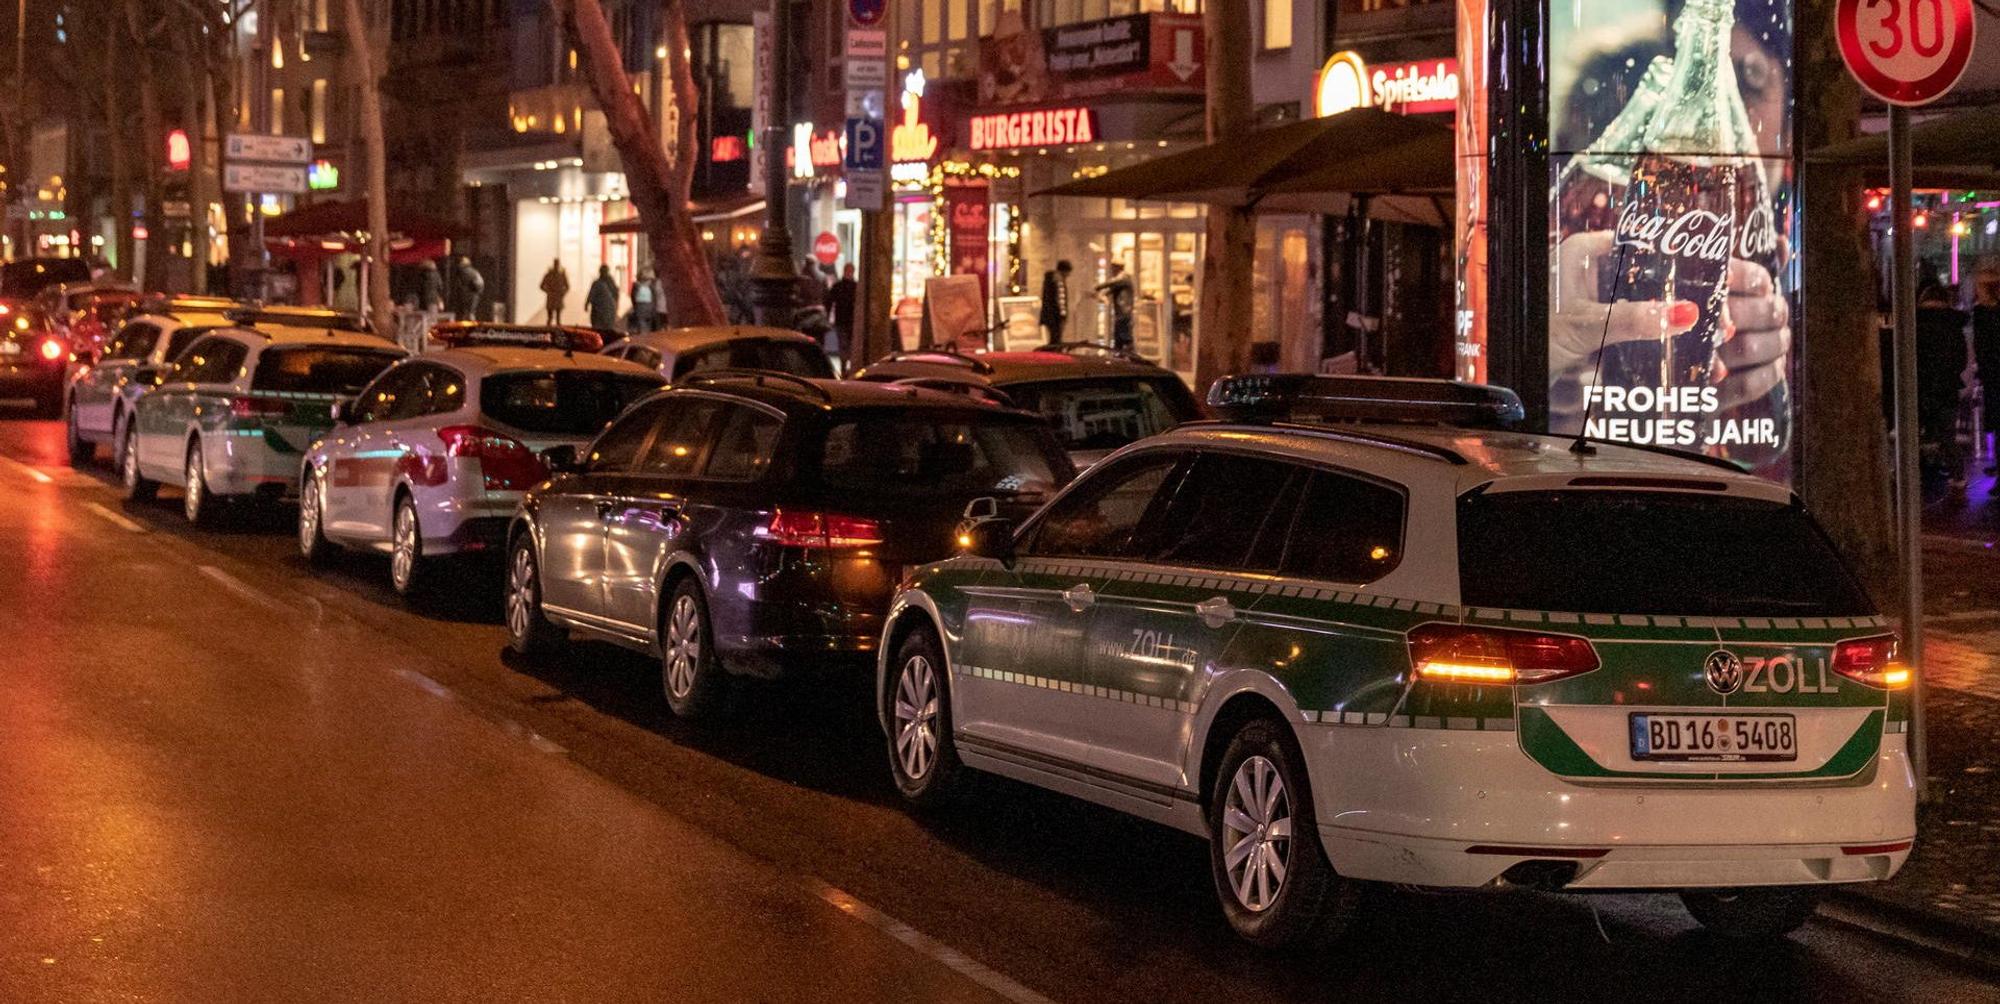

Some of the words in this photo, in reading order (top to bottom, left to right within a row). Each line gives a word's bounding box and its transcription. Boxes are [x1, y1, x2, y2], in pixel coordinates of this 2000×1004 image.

[1867, 0, 1944, 58] 30
[1372, 62, 1459, 112] Spielsalo
[970, 107, 1092, 150] BURGERISTA
[1615, 200, 1732, 260] Coca-Cola
[1583, 385, 1719, 413] FROHES
[1584, 418, 1697, 445] NEUES
[1704, 417, 1780, 448] JAHR,
[1743, 654, 1839, 693] ZOLL
[1736, 720, 1792, 750] 5408
